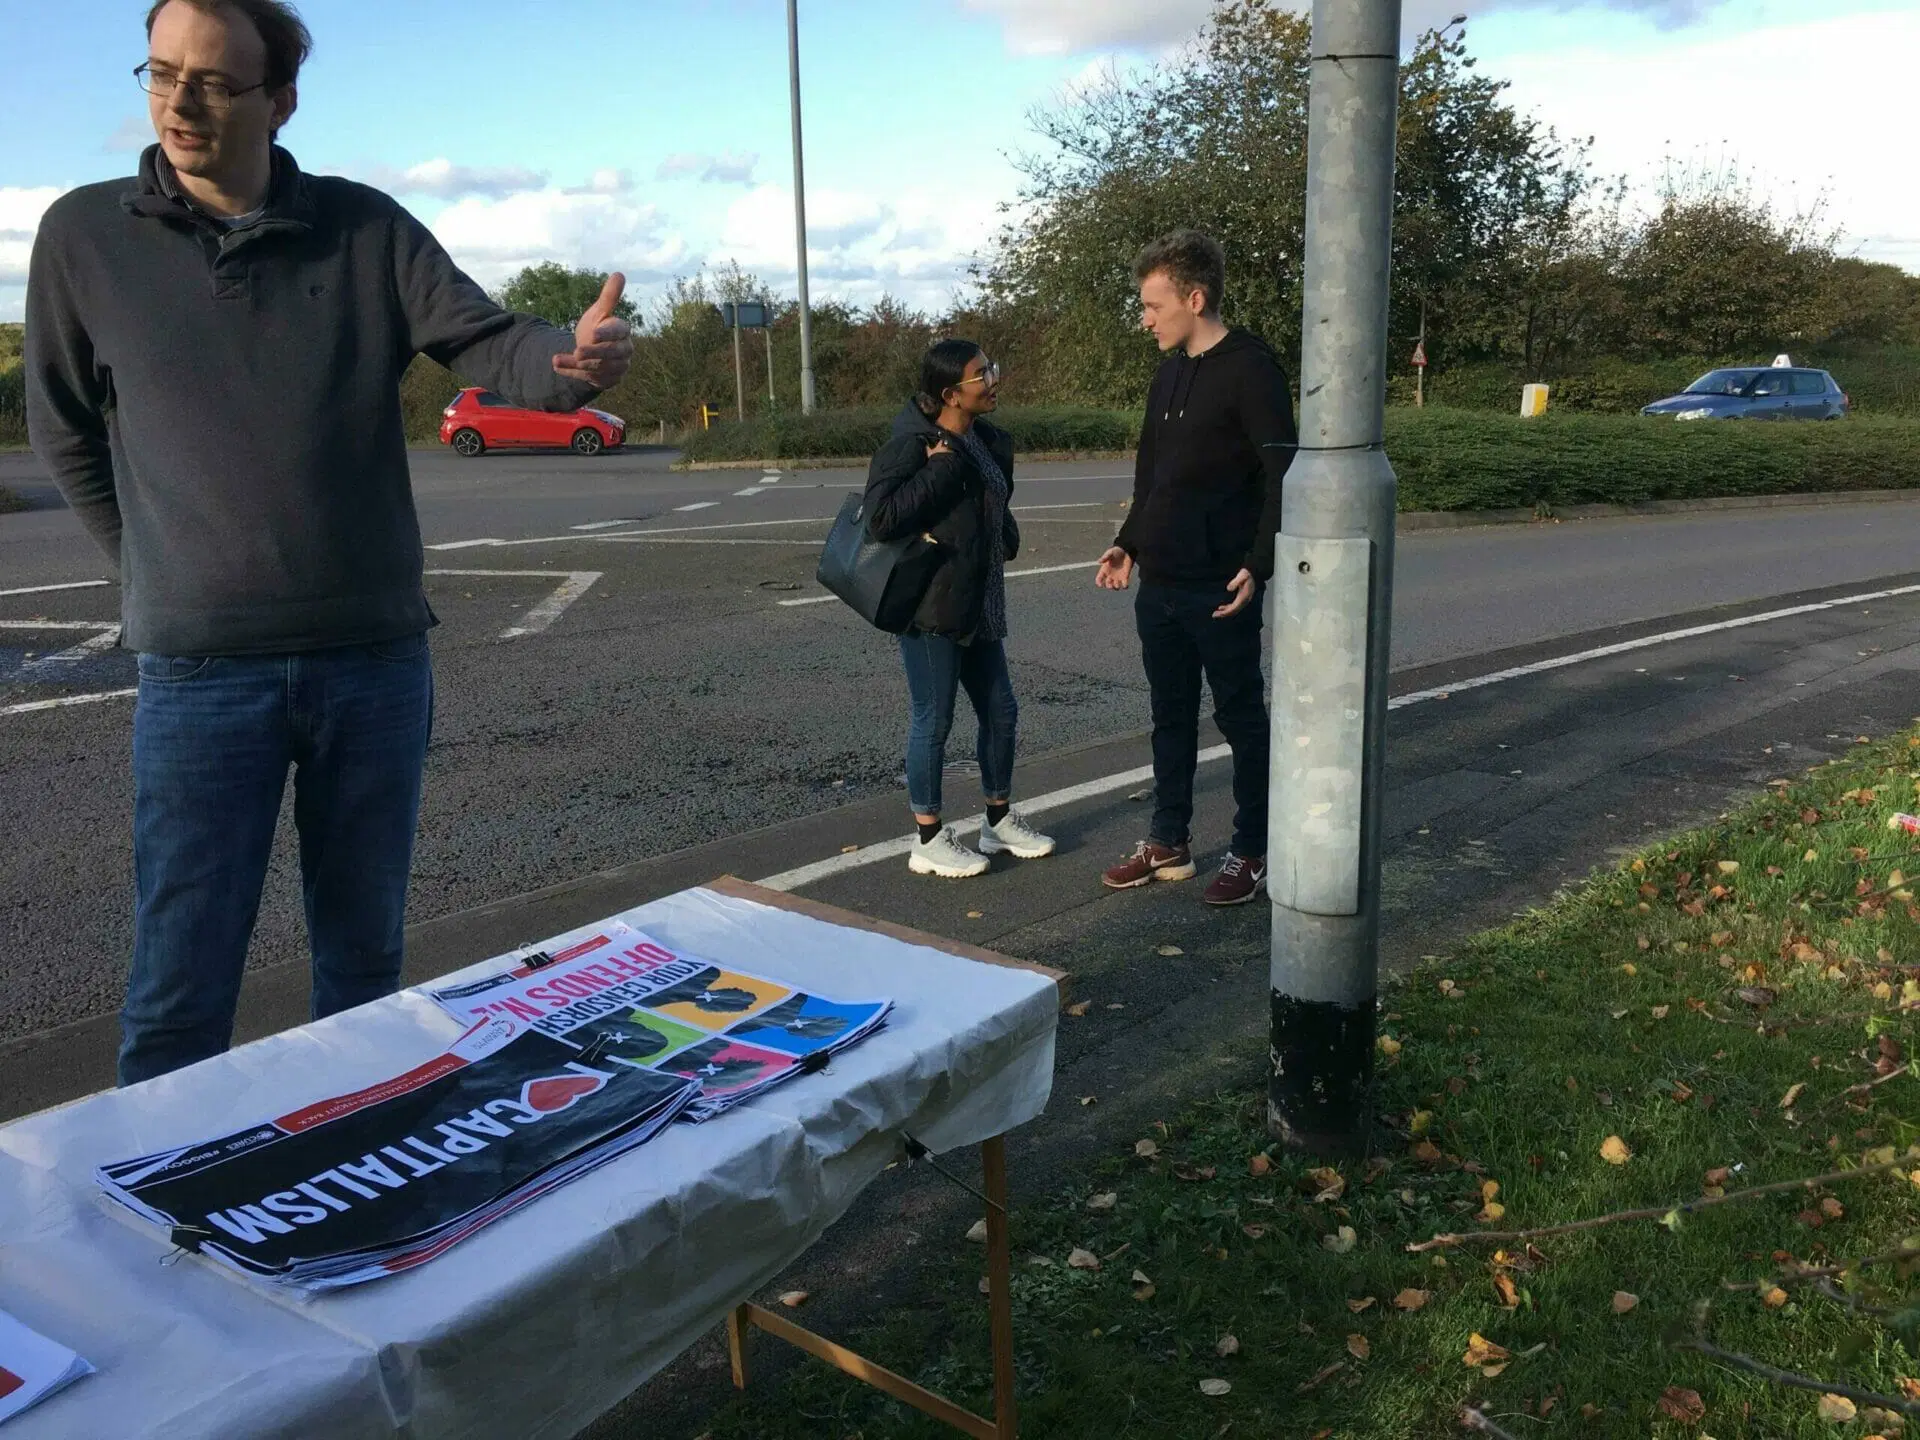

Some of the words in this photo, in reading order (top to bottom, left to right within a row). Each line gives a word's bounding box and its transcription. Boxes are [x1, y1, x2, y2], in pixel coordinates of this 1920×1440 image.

[525, 942, 676, 1007] OFFENDS
[639, 959, 706, 986] YOUR
[532, 980, 652, 1034] CENSORSH
[206, 1099, 545, 1244] CAPITALISM
